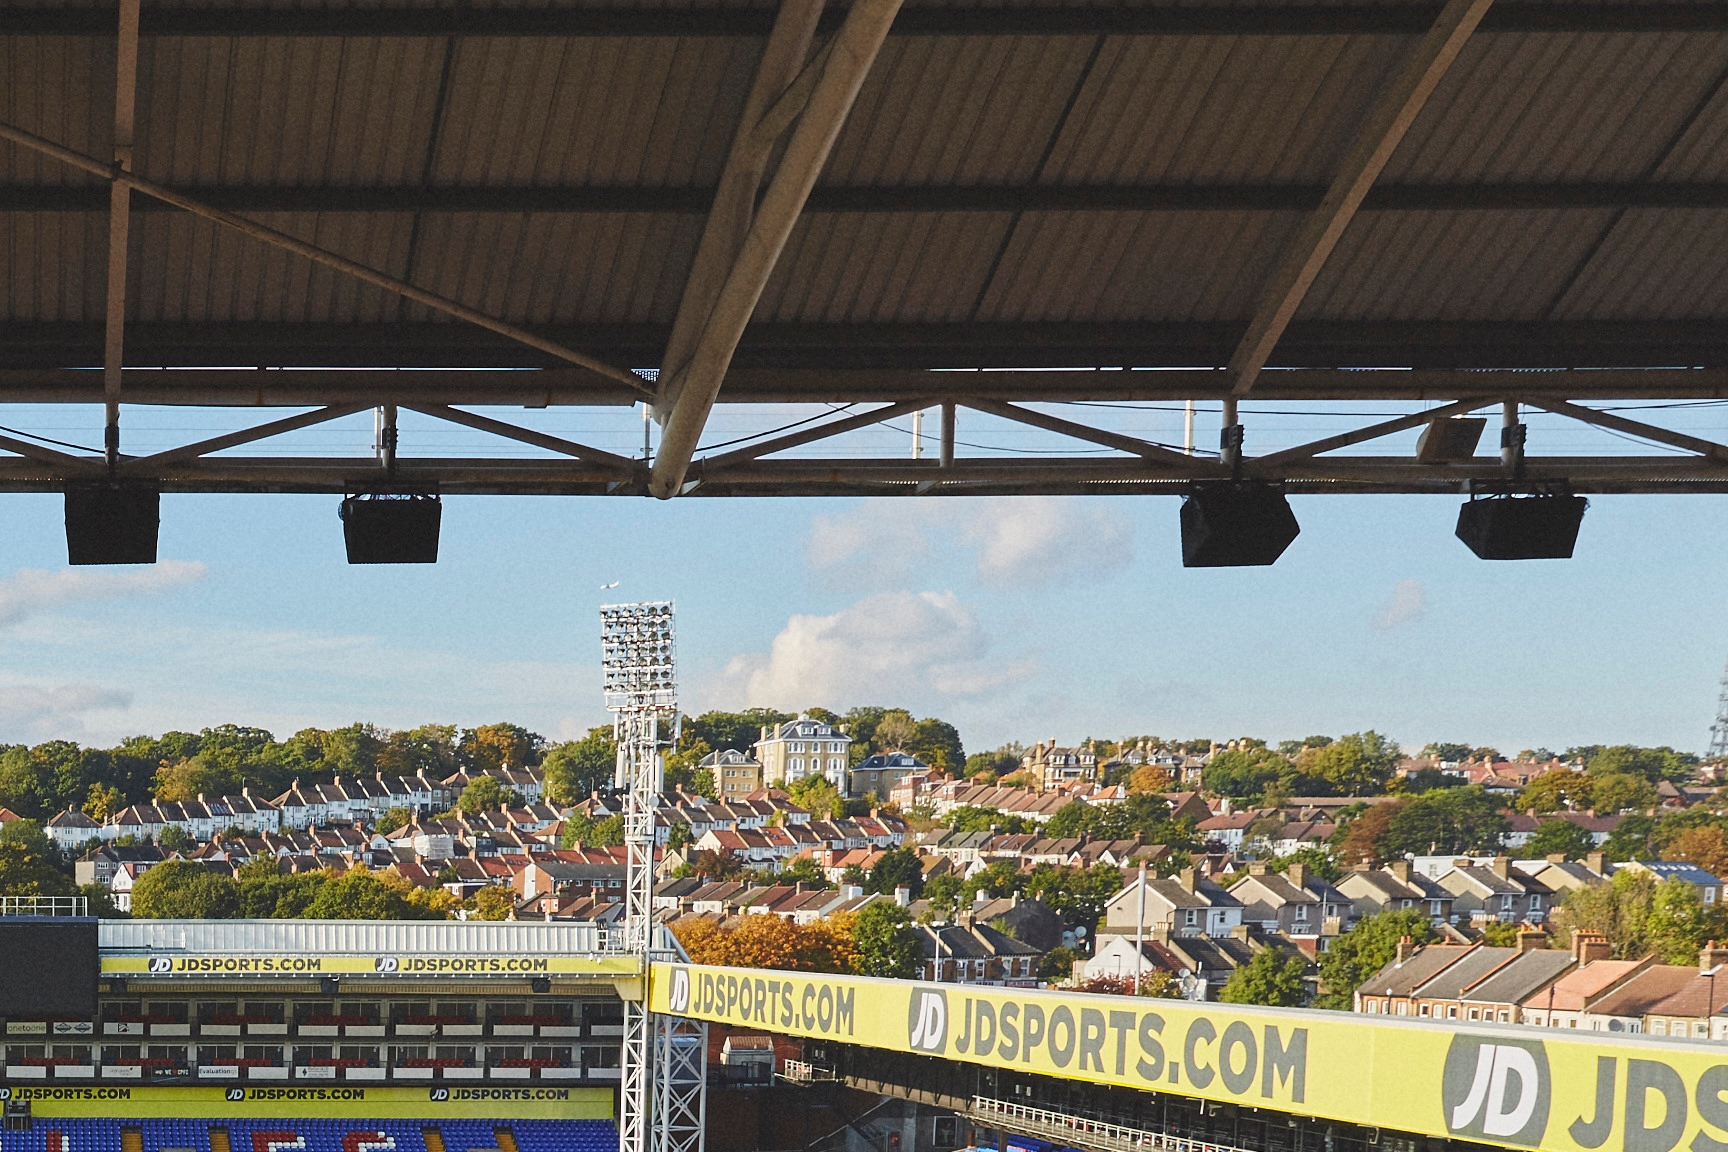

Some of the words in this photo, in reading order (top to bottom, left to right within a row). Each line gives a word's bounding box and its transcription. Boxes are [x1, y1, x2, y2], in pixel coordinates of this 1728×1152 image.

[177, 958, 321, 971] JDSPORTS.COM
[403, 958, 548, 971] JDSPORTS.COM
[670, 969, 688, 1013] JD
[693, 972, 855, 1036] JDSPORTS.COM
[7, 1024, 46, 1032] onetoone
[911, 992, 945, 1050] JD
[955, 997, 1308, 1104] JDSPORTS.COM
[15, 1088, 130, 1100] JDSPORTS.COM
[248, 1089, 364, 1100] JDSPORTS.COM
[452, 1088, 569, 1100] JDSPORTS.COM
[1452, 1043, 1539, 1137] JD
